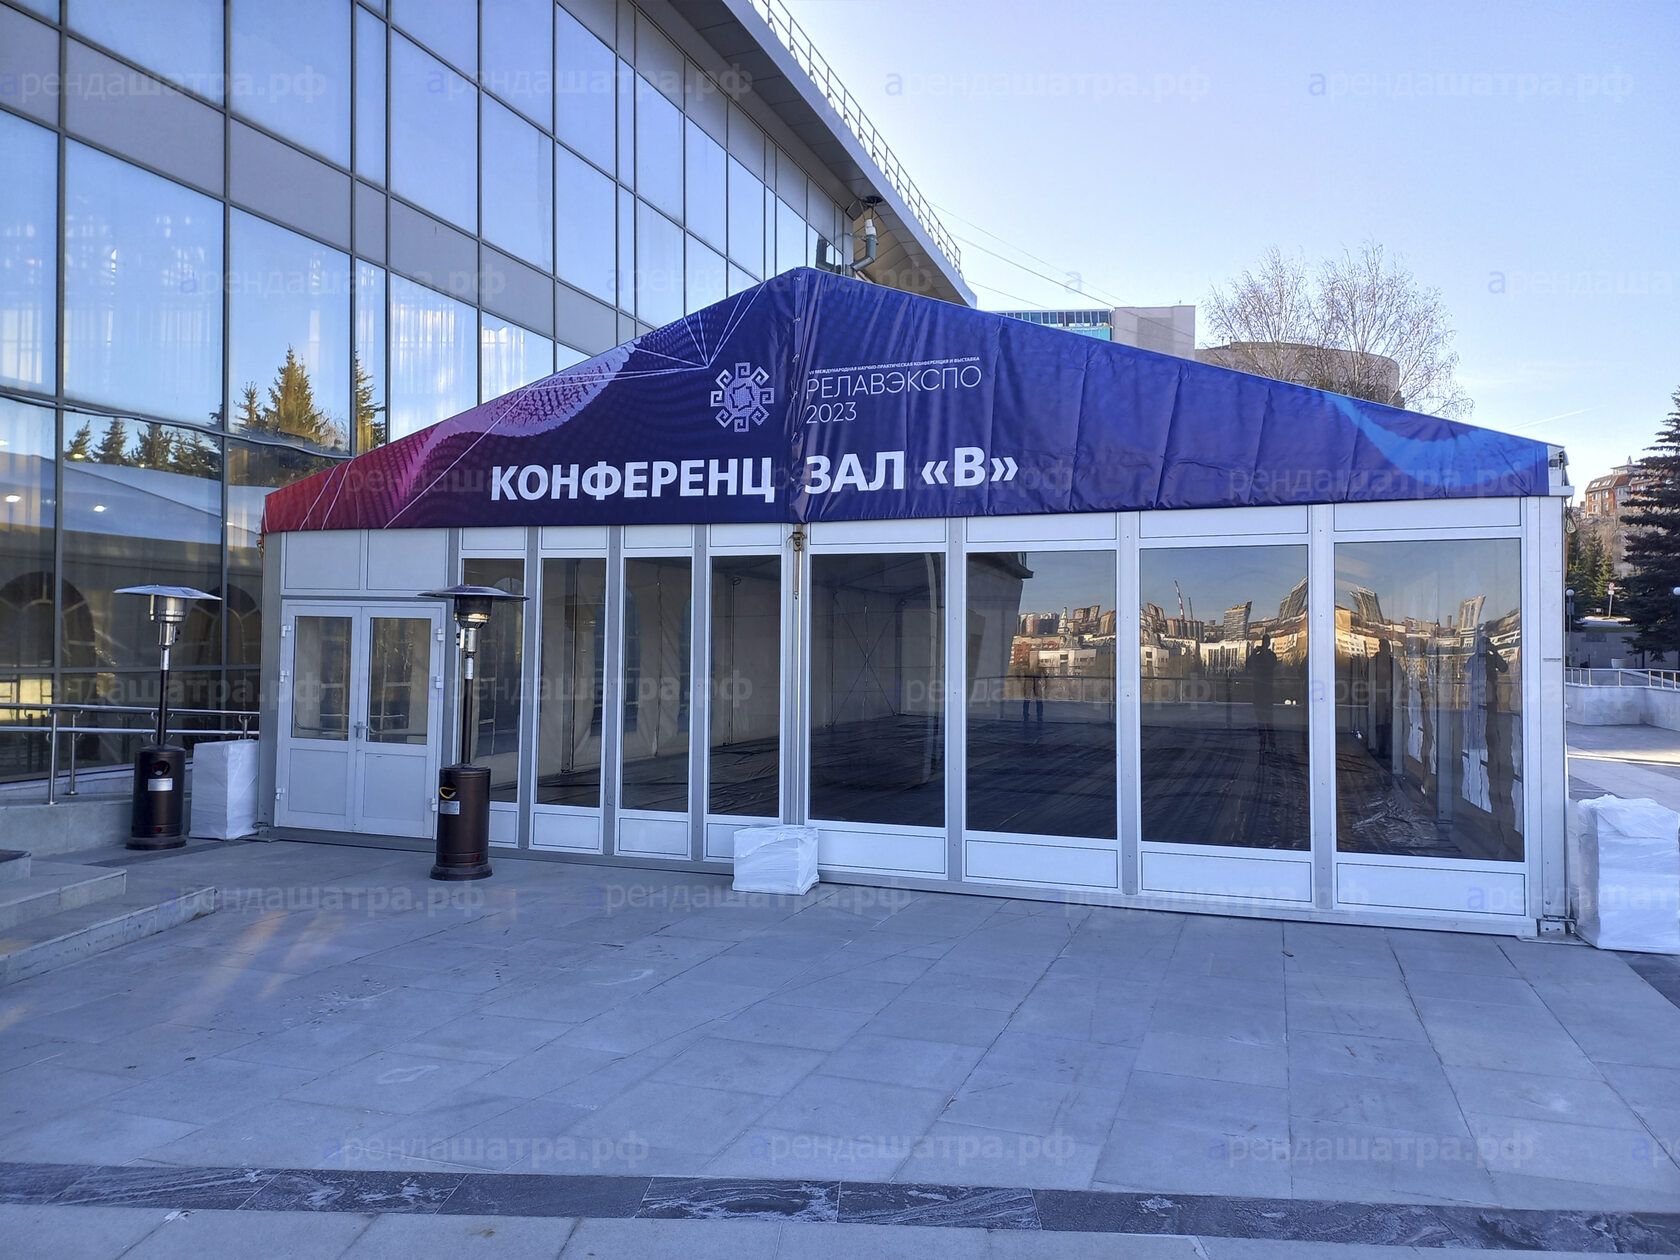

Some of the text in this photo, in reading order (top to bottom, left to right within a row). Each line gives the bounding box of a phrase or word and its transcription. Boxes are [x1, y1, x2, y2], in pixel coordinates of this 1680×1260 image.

[805, 365, 982, 400] РЕЛАВЭКСПО
[806, 402, 857, 424] 2023
[490, 457, 775, 503] КОНФЕРЕНЦ
[804, 451, 905, 494] ЗАЛ
[921, 446, 1019, 487] «В»
